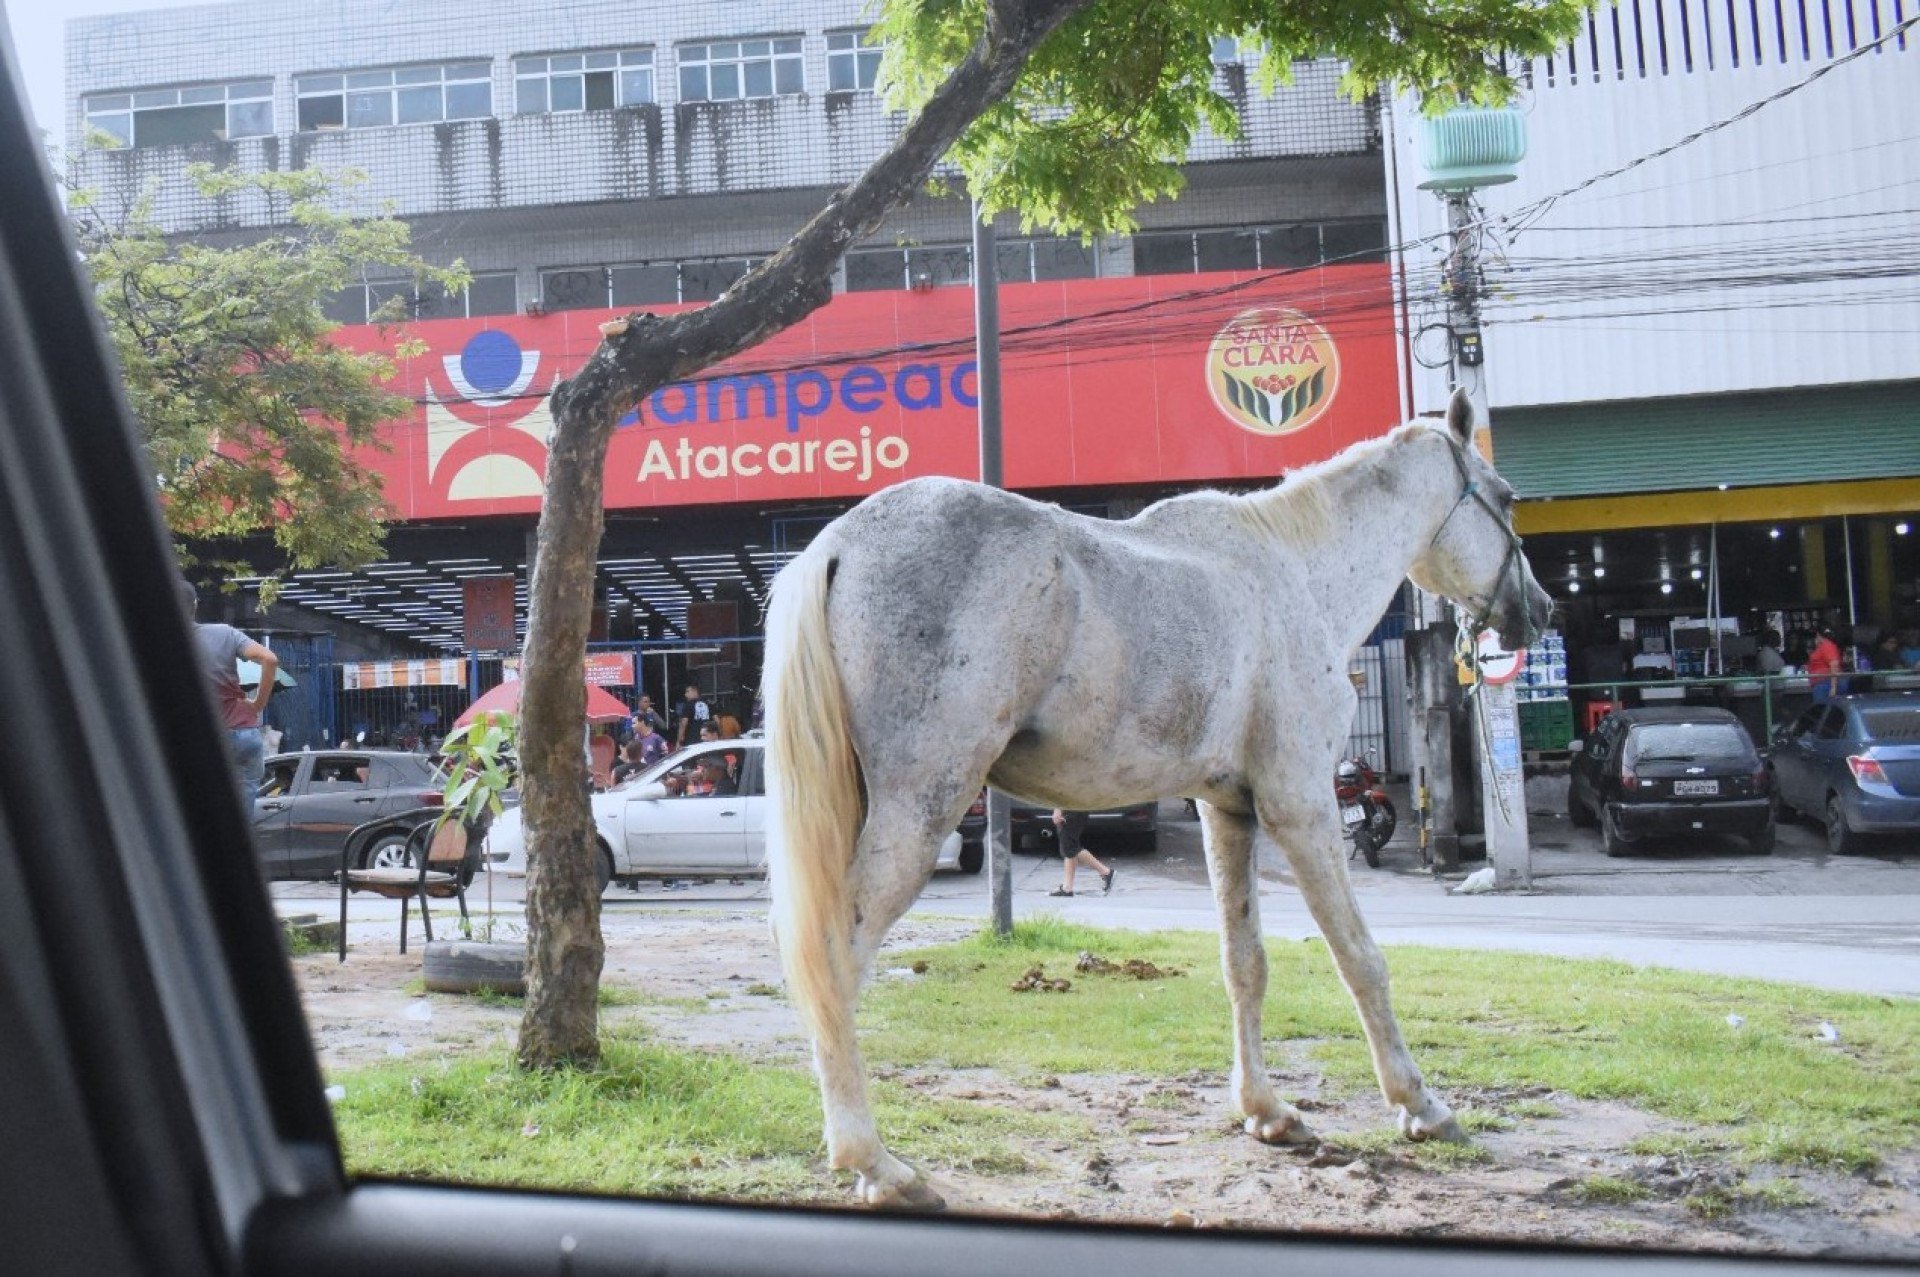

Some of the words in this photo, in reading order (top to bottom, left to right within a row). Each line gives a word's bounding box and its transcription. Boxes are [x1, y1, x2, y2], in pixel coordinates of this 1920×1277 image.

[1231, 326, 1308, 346] SANTA
[1223, 343, 1320, 368] CLARA
[637, 425, 909, 483] Atacarejo
